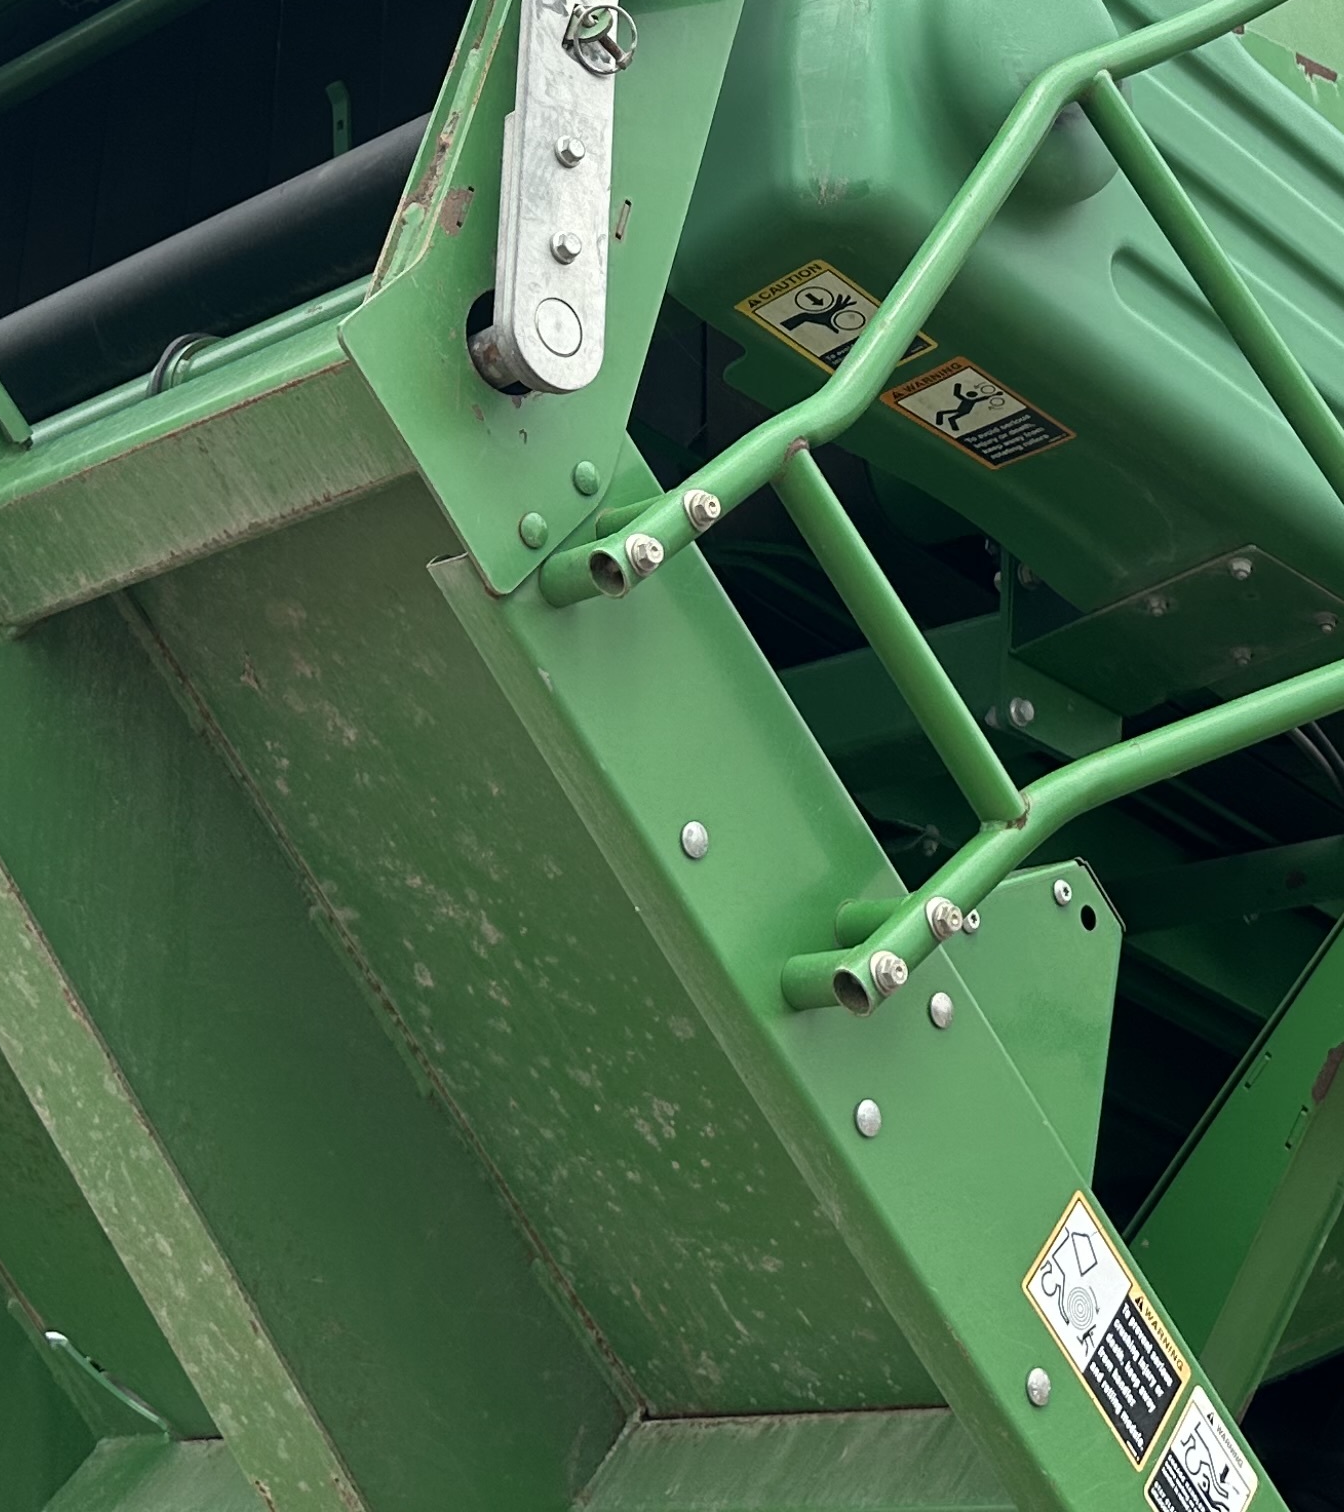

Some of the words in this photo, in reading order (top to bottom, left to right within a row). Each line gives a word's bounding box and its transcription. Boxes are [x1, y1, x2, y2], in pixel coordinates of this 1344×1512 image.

[758, 263, 823, 300] CAUTION
[905, 363, 962, 393] WARNING
[1098, 1346, 1113, 1372] from
[1114, 1319, 1140, 1362] crushing
[1138, 1356, 1156, 1387] injury
[1122, 1303, 1131, 1319] To
[1128, 1317, 1153, 1354] prevent
[1150, 1351, 1173, 1387] serious
[1145, 1307, 1185, 1371] WARNING
[1090, 1362, 1104, 1383] and
[1124, 1361, 1140, 1388] keep
[1139, 1386, 1156, 1412] away
[1216, 1425, 1243, 1468] WARNING
